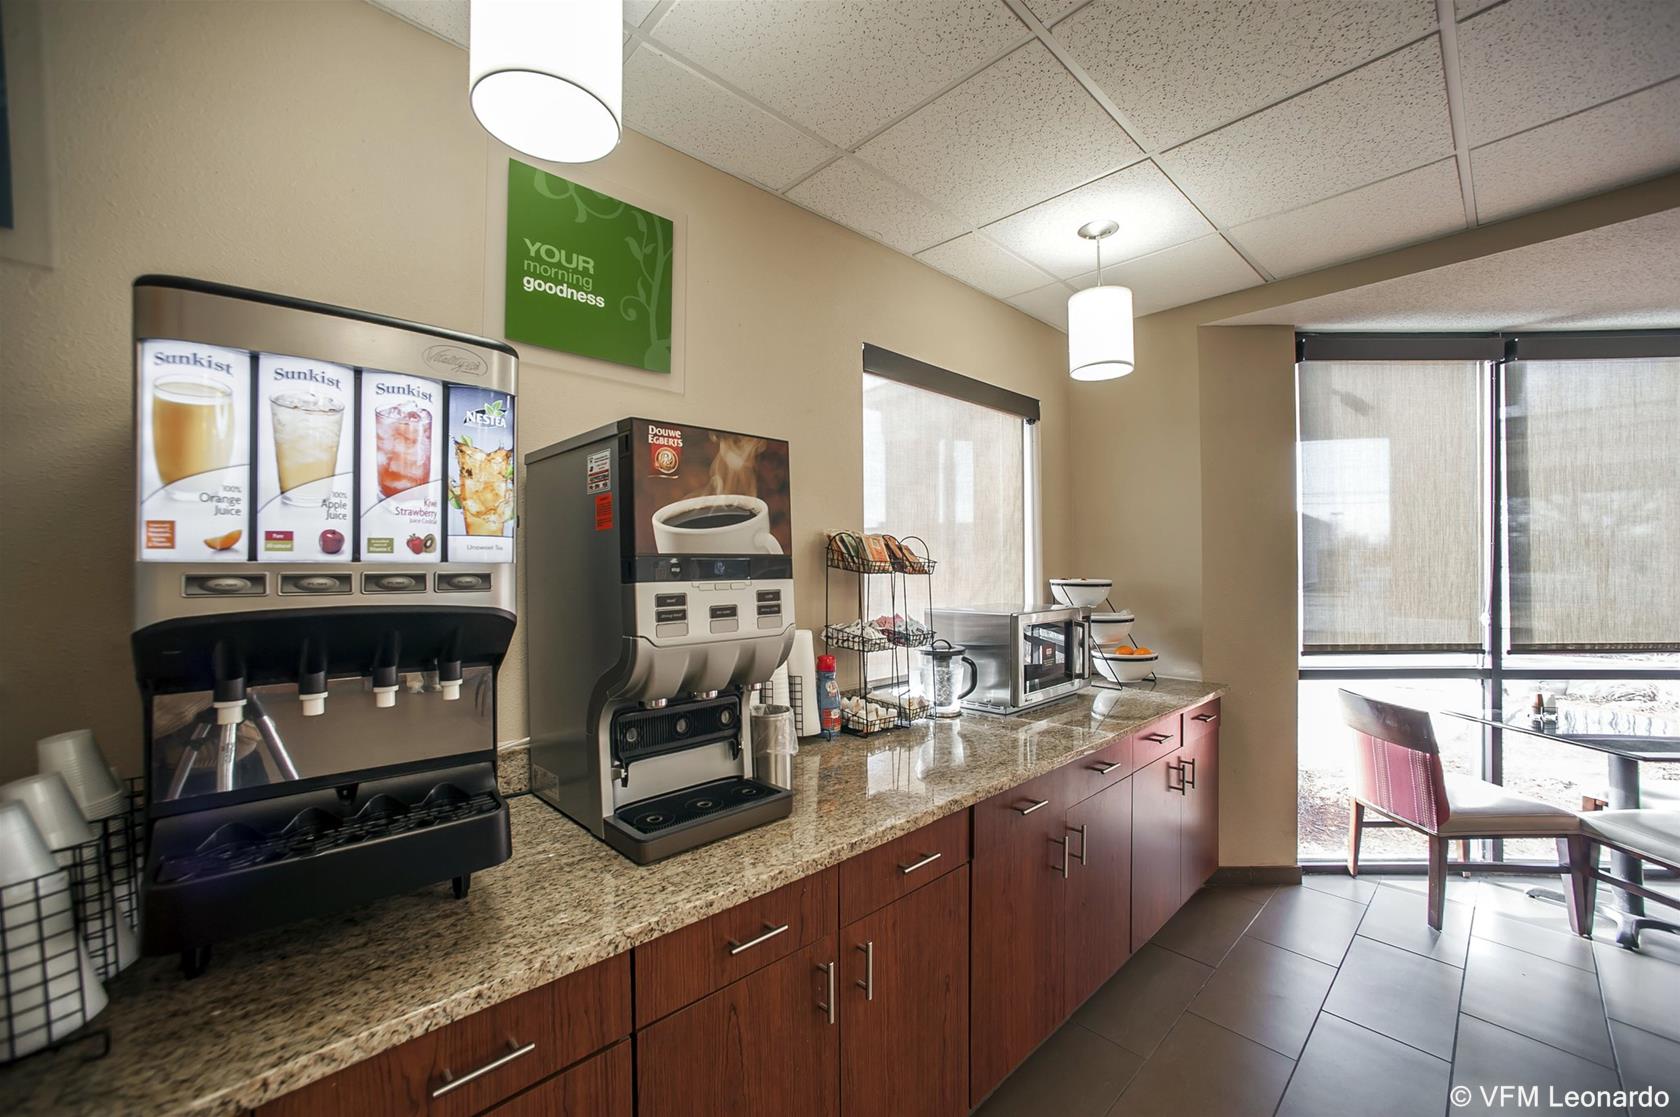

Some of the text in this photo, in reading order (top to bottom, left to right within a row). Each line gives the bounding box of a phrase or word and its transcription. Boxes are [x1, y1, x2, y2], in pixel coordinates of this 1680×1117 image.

[523, 238, 595, 275] YOUR
[523, 259, 593, 292] morning
[522, 276, 605, 308] goodness
[153, 351, 234, 378] Sunkist
[273, 367, 342, 392] Sunkist
[375, 382, 433, 404] Sunkist
[466, 410, 507, 428] NESTEA
[648, 424, 682, 438] Douwe
[648, 434, 684, 447] EGBERTS
[199, 491, 242, 507] Orange
[320, 498, 348, 513] Apple
[214, 505, 242, 517] Juice
[325, 510, 348, 521] Juice
[395, 505, 438, 519] Strawberry
